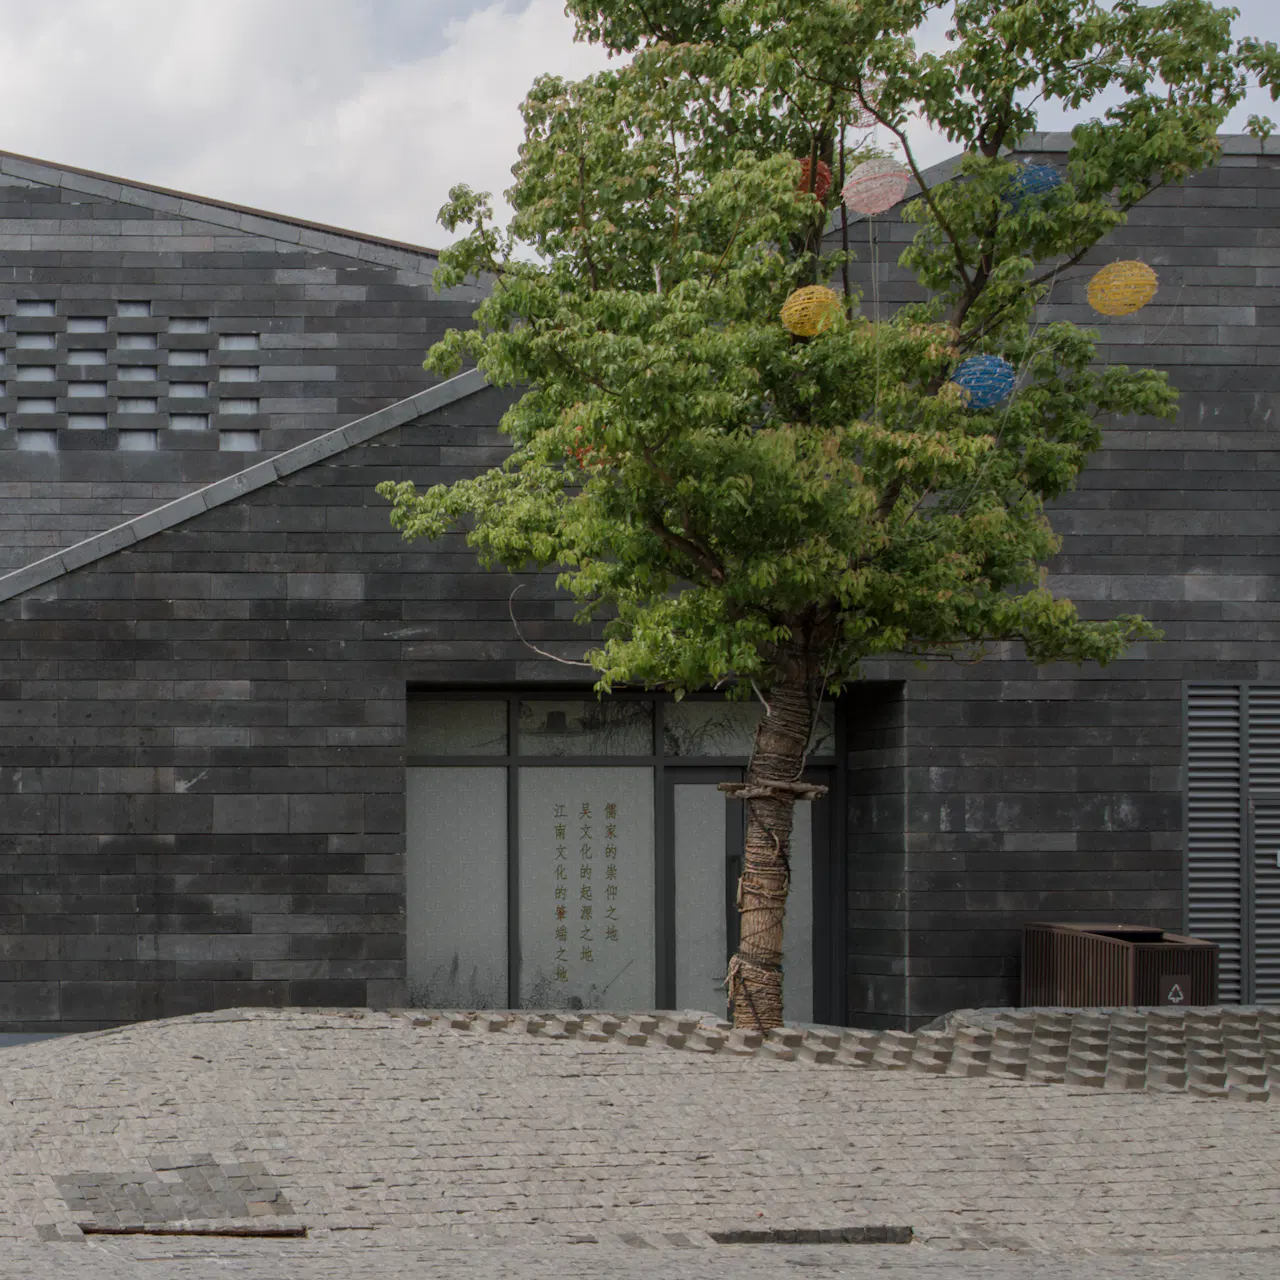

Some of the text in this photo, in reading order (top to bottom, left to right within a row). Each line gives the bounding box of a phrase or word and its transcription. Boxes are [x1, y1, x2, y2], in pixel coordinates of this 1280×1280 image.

[579, 802, 594, 963] 吴文化的起源之地
[603, 801, 620, 943] 儒家的崇仰之地
